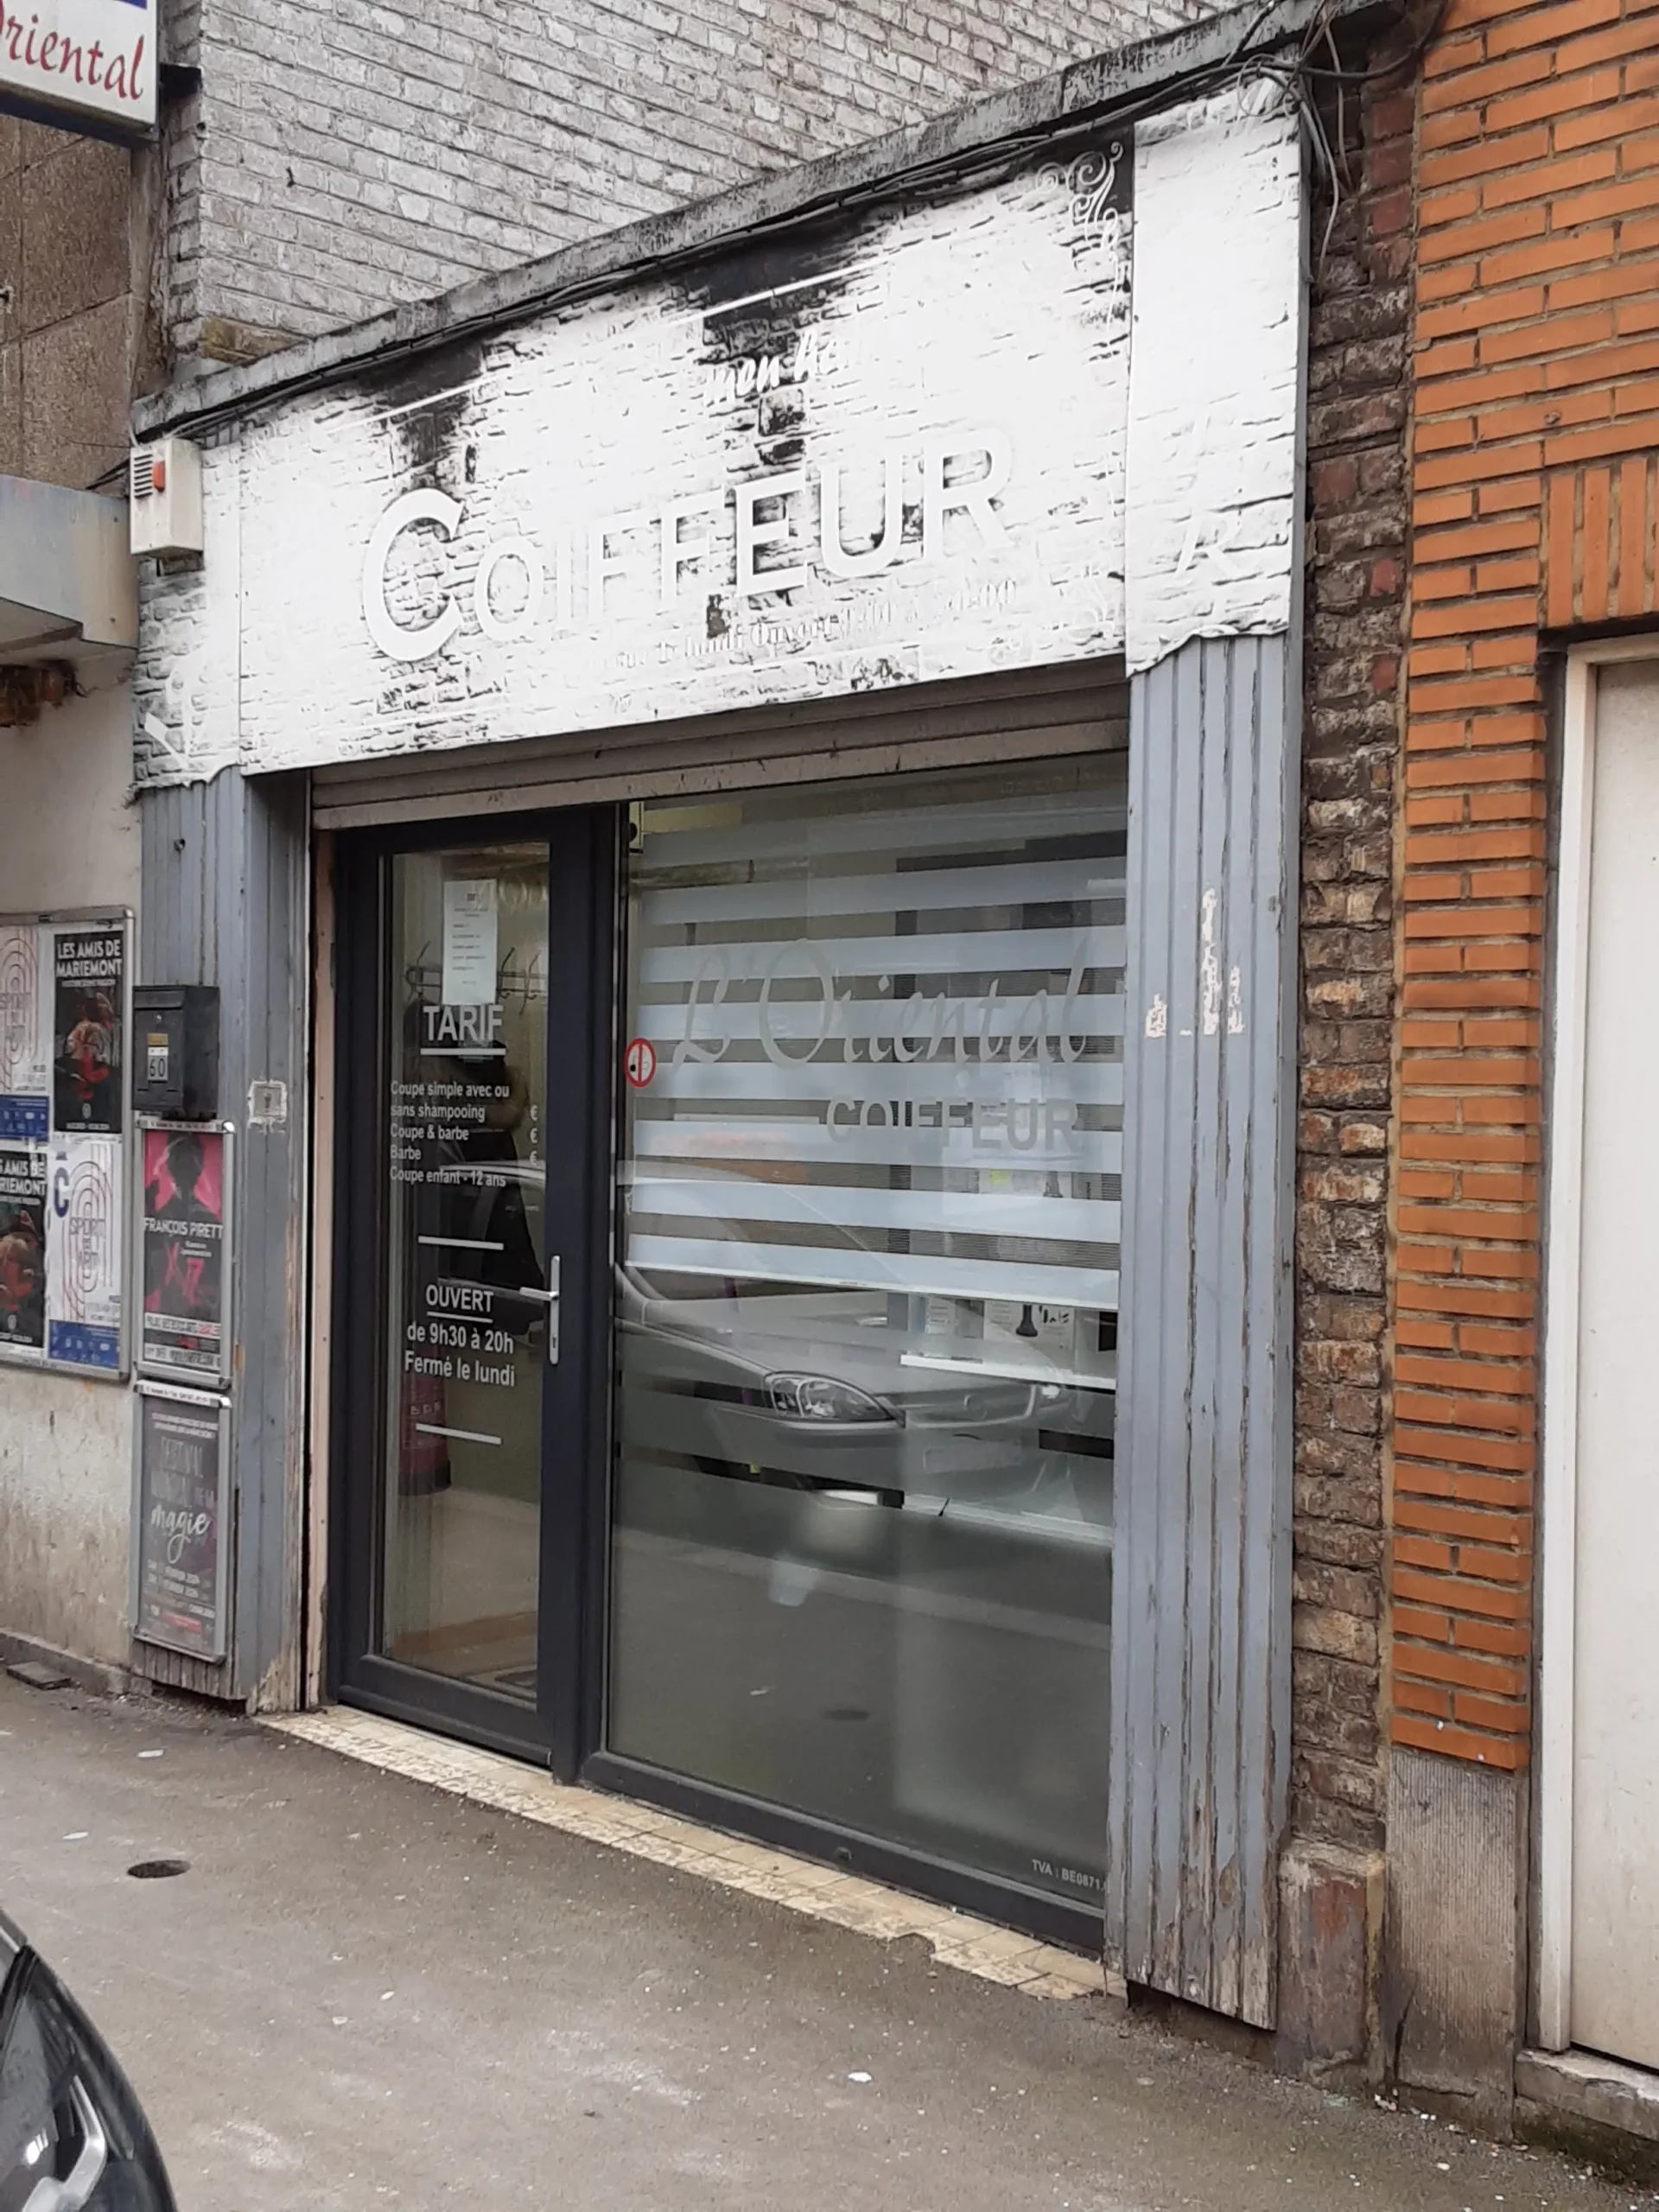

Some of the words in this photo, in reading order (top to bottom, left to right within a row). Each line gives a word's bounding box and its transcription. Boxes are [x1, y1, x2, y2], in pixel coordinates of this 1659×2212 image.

[0, 0, 145, 101] riental
[57, 941, 76, 959] LES
[77, 940, 104, 959] AMIS
[105, 939, 121, 957] DE
[56, 958, 123, 978] MARIEMONT
[423, 1004, 505, 1042] TARIF
[391, 1080, 425, 1098] Coupe
[428, 1081, 463, 1100] simple
[466, 1084, 493, 1098] avec
[494, 1085, 510, 1098] ou
[391, 1104, 416, 1117] sans
[418, 1103, 486, 1123] shampooing
[391, 1123, 424, 1141] Coupe
[427, 1124, 435, 1140] &
[438, 1124, 469, 1141] barbe
[824, 1094, 1079, 1153] COIFFEUR
[390, 1144, 422, 1160] Barbe
[4, 1159, 29, 1176] AMIS
[390, 1166, 424, 1185] Coupe
[426, 1169, 460, 1185] enfant
[470, 1170, 484, 1186] 12
[486, 1174, 507, 1188] ans
[143, 1217, 188, 1237] FRANÇOIS
[426, 1284, 494, 1313] OUVERT
[407, 1321, 426, 1341] de
[429, 1323, 467, 1347] 9h30
[471, 1327, 480, 1350] à
[485, 1330, 514, 1354] 20h
[404, 1350, 452, 1376] Fermé
[457, 1358, 470, 1380] le
[475, 1360, 515, 1387] lundi
[150, 1503, 211, 1565] magie
[1032, 1859, 1053, 1876] TVA
